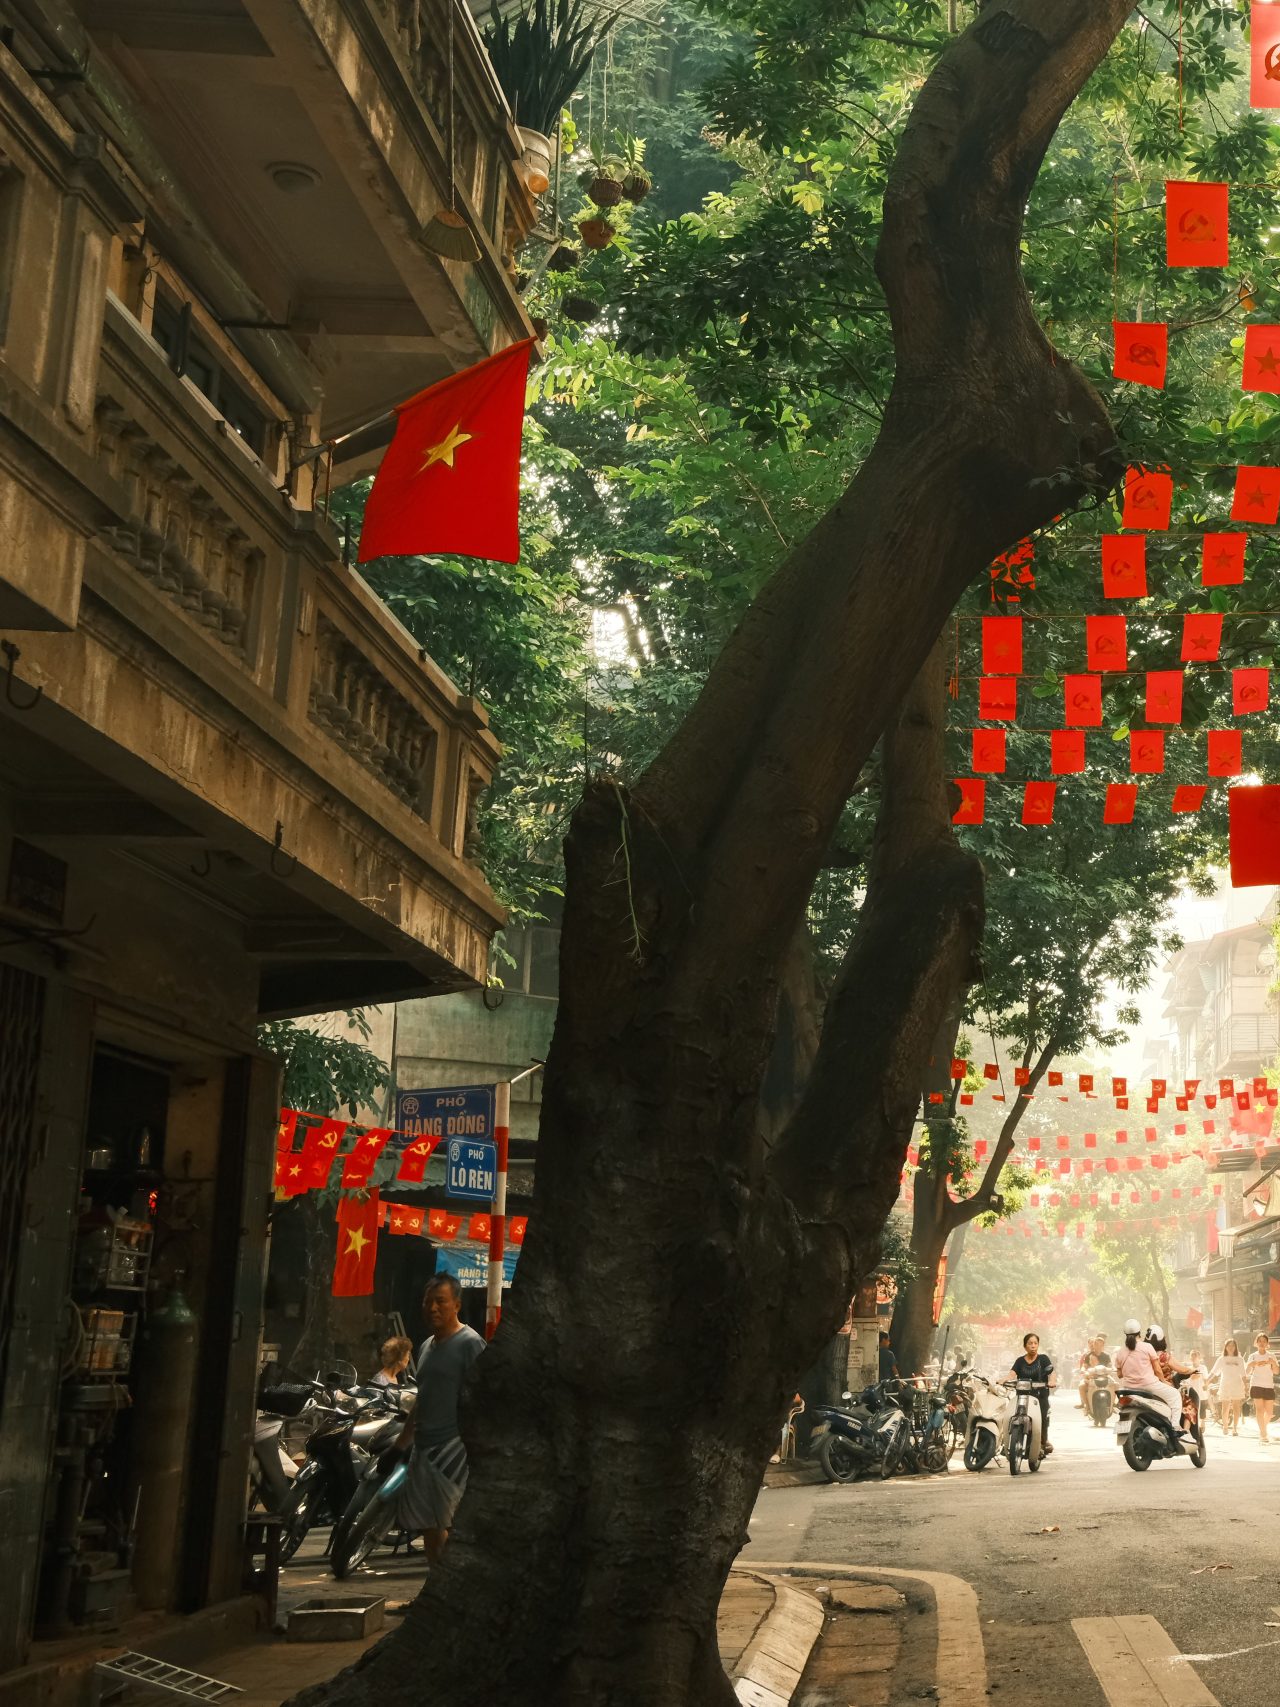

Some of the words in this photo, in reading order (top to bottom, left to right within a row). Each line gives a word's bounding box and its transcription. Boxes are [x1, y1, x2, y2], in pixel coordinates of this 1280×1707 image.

[436, 1092, 466, 1108] PHỐ
[404, 1114, 442, 1138] HÀNG
[447, 1110, 485, 1135] ĐỒNG
[468, 1147, 484, 1161] PHỐ
[452, 1162, 466, 1187] LÒ
[469, 1165, 492, 1191] RÈN
